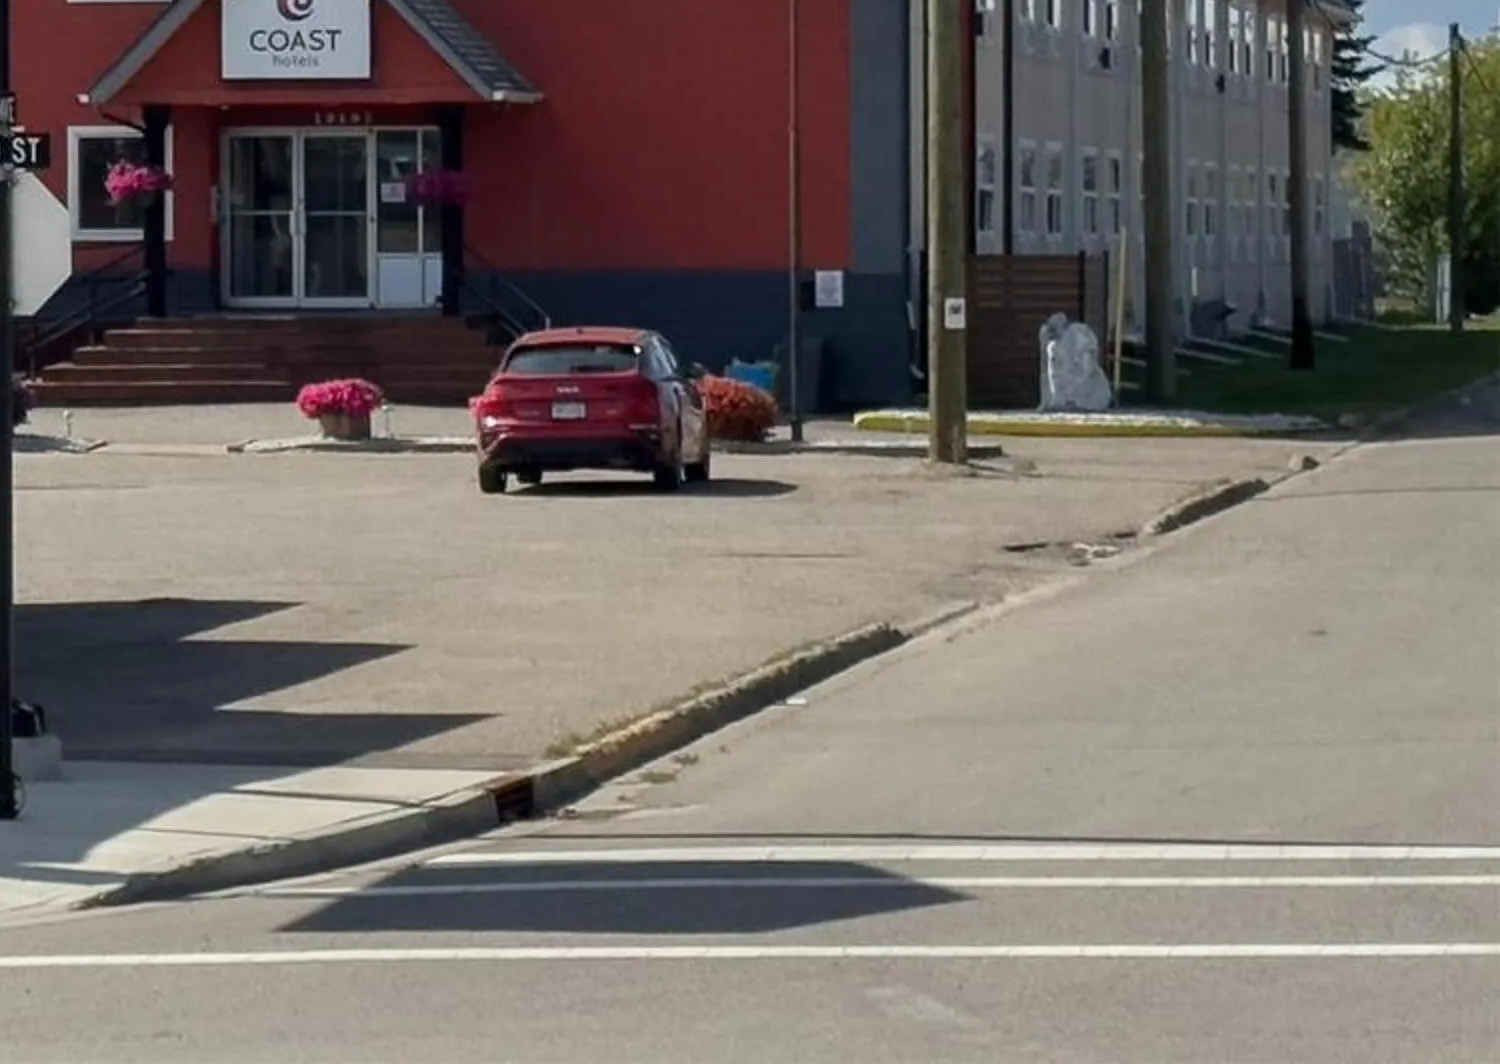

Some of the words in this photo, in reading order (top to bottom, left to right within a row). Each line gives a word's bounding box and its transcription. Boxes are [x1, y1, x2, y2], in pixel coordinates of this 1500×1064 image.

[250, 29, 342, 52] COAST
[273, 54, 319, 68] hotels
[11, 136, 41, 164] ST
